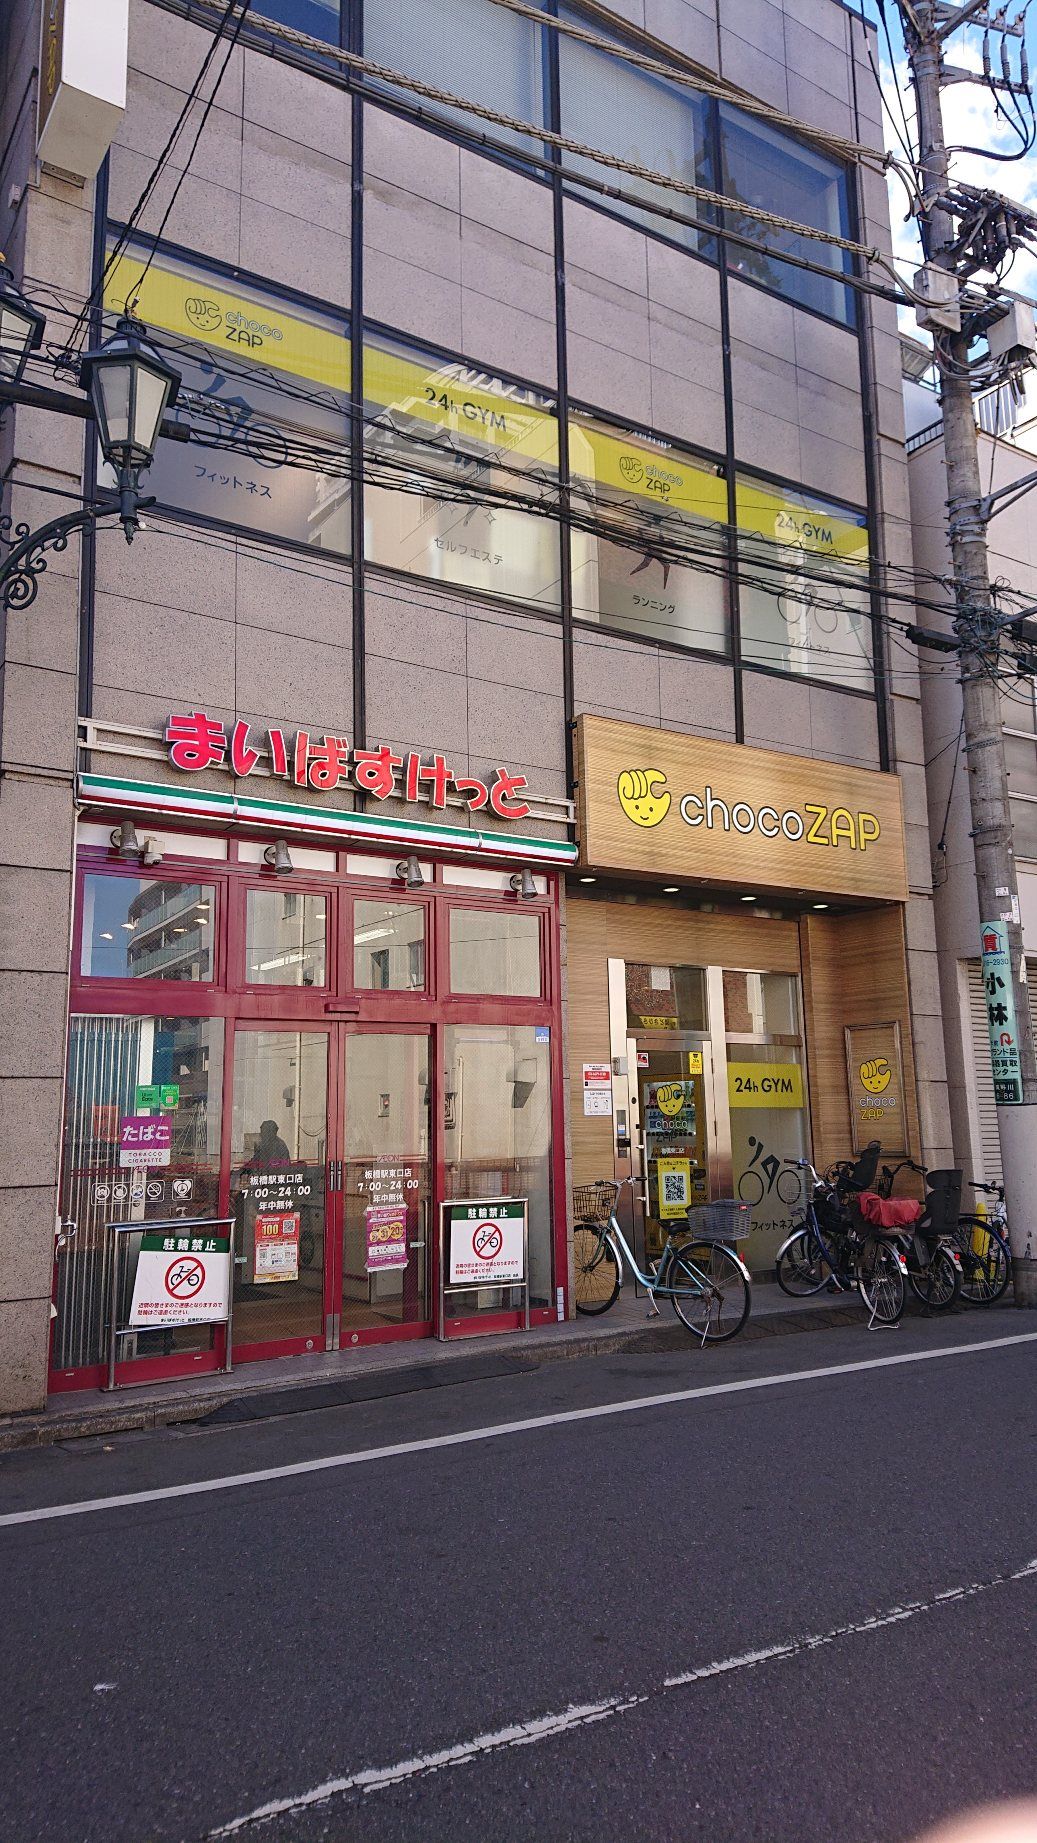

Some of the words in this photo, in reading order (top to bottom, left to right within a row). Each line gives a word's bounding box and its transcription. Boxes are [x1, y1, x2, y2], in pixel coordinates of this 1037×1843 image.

[225, 311, 283, 341] choco
[225, 325, 263, 348] ZAP
[425, 387, 458, 414] 24h
[462, 401, 507, 432] GYM
[194, 465, 272, 499] フィットネス
[645, 464, 684, 487] choco
[645, 476, 671, 494] ZAP
[776, 512, 800, 534] 24h
[802, 522, 833, 545] GYM
[434, 537, 504, 565] セルフエステ
[632, 594, 676, 614] ランニング
[163, 711, 531, 819] まいばすけっと
[680, 786, 881, 851] chocoZAP
[985, 972, 1009, 1027] 小林
[735, 1077, 759, 1093] 24h
[761, 1077, 793, 1093] GYM
[859, 1095, 896, 1107] choco
[860, 1108, 885, 1120] ZAP
[122, 1124, 170, 1142] たばこ
[127, 1157, 163, 1165] CIGARETTE
[249, 1173, 304, 1186] 板橋駅東口店
[364, 1168, 413, 1180] 板橋駅東口店
[258, 1199, 294, 1211] 年中無休
[372, 1193, 404, 1204] 年中無休
[467, 1206, 509, 1219] 駐輪禁止
[262, 1224, 279, 1236] 100
[750, 1218, 795, 1231] フィットネス
[162, 1238, 217, 1252] 駐輪禁止
